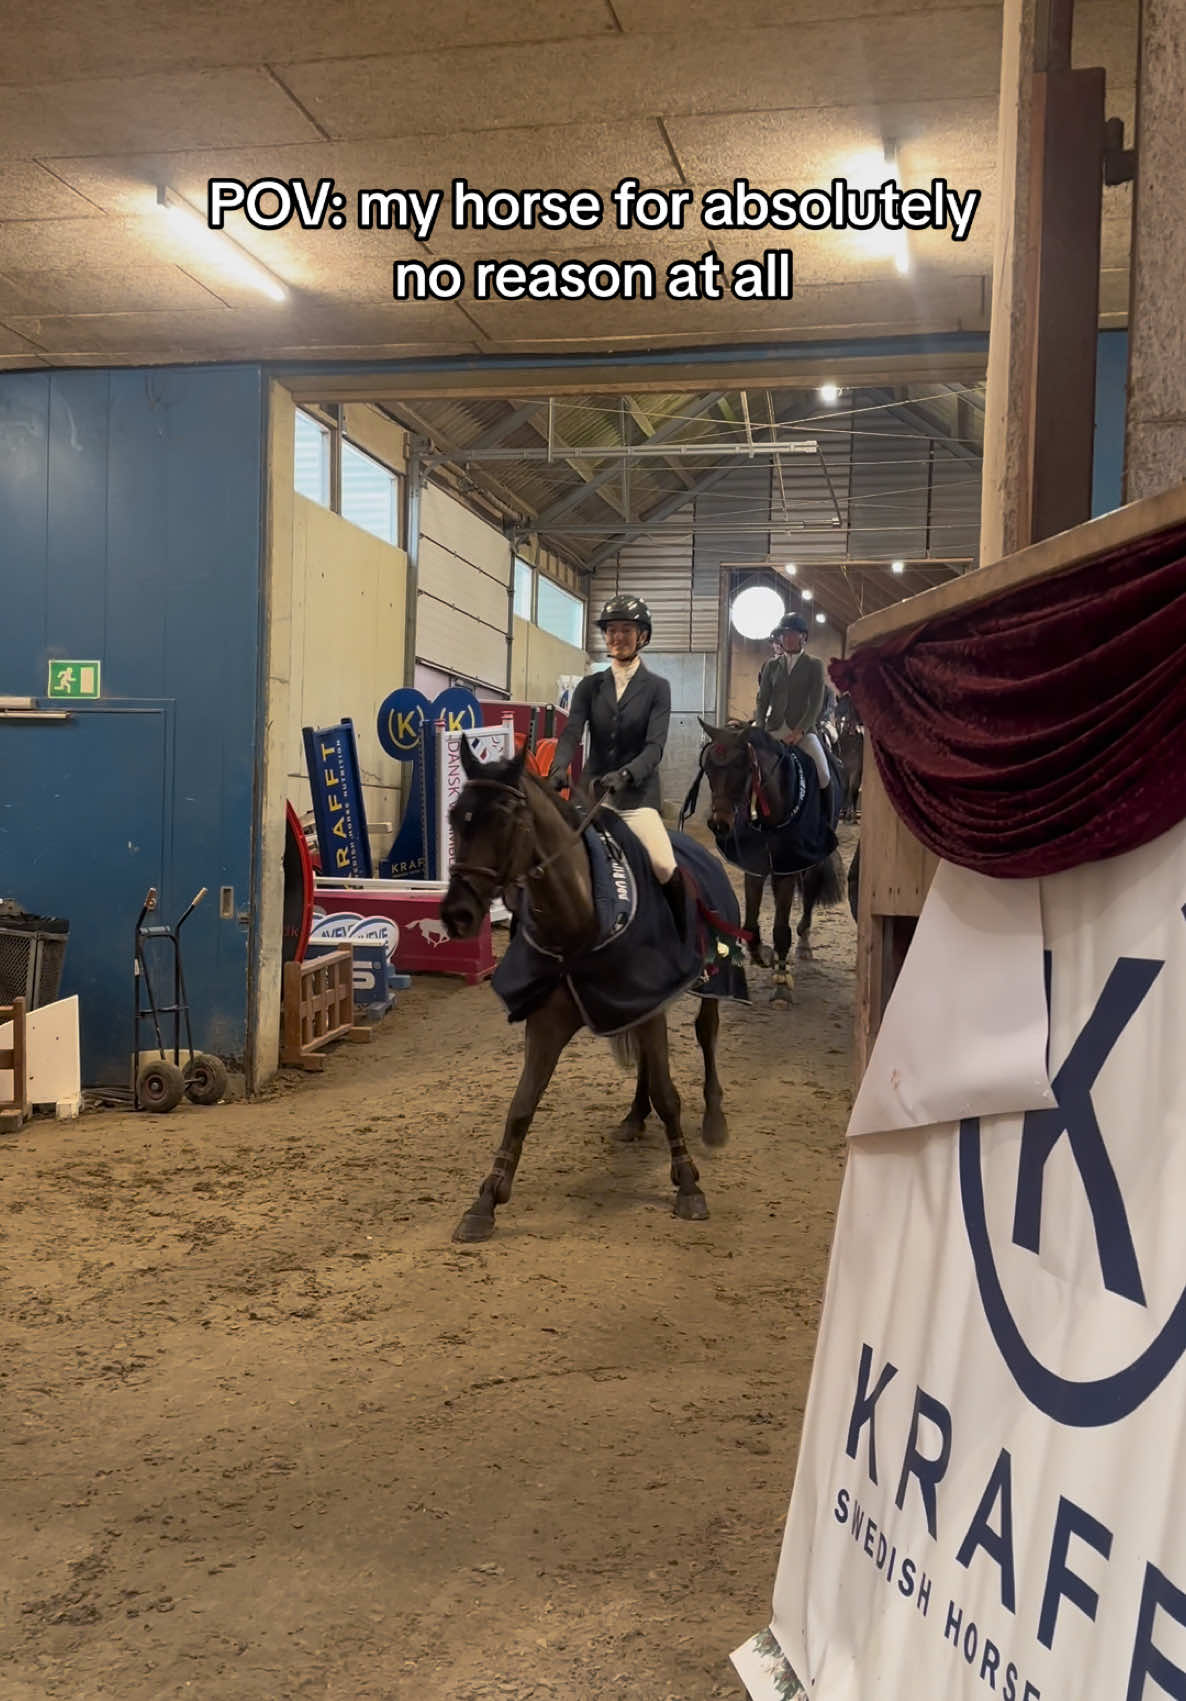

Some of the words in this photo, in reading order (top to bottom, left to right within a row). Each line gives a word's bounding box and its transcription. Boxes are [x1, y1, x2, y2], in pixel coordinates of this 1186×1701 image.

[397, 711, 416, 739] K
[447, 740, 462, 797] DANSK
[321, 743, 350, 878] RAFFT
[833, 1488, 932, 1617] SWEDISH
